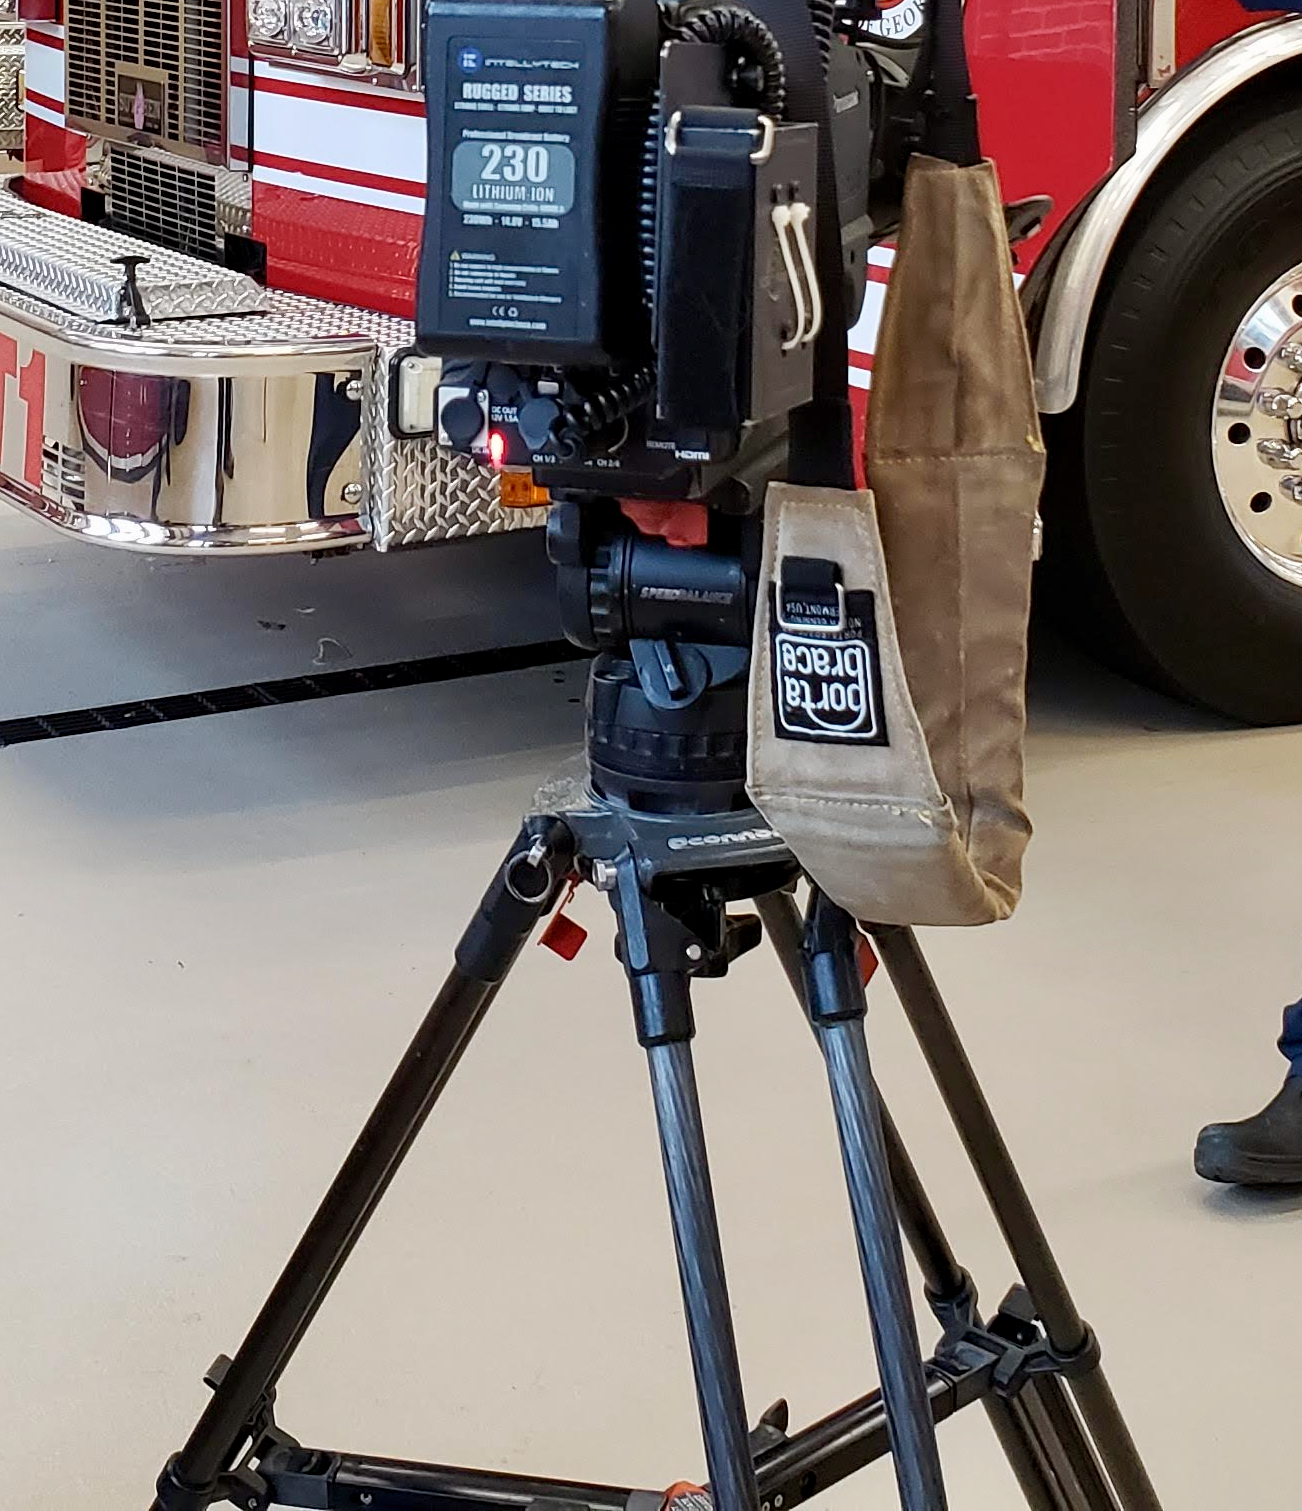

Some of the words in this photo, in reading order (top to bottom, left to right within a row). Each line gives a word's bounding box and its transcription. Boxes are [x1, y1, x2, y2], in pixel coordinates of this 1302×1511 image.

[462, 82, 519, 101] RUGGED
[523, 85, 573, 104] SERIES
[481, 144, 549, 183] 230
[472, 184, 555, 202] LITHIUM-ION
[675, 449, 710, 461] HDMI
[782, 642, 863, 677] brace
[784, 675, 866, 716] porta
